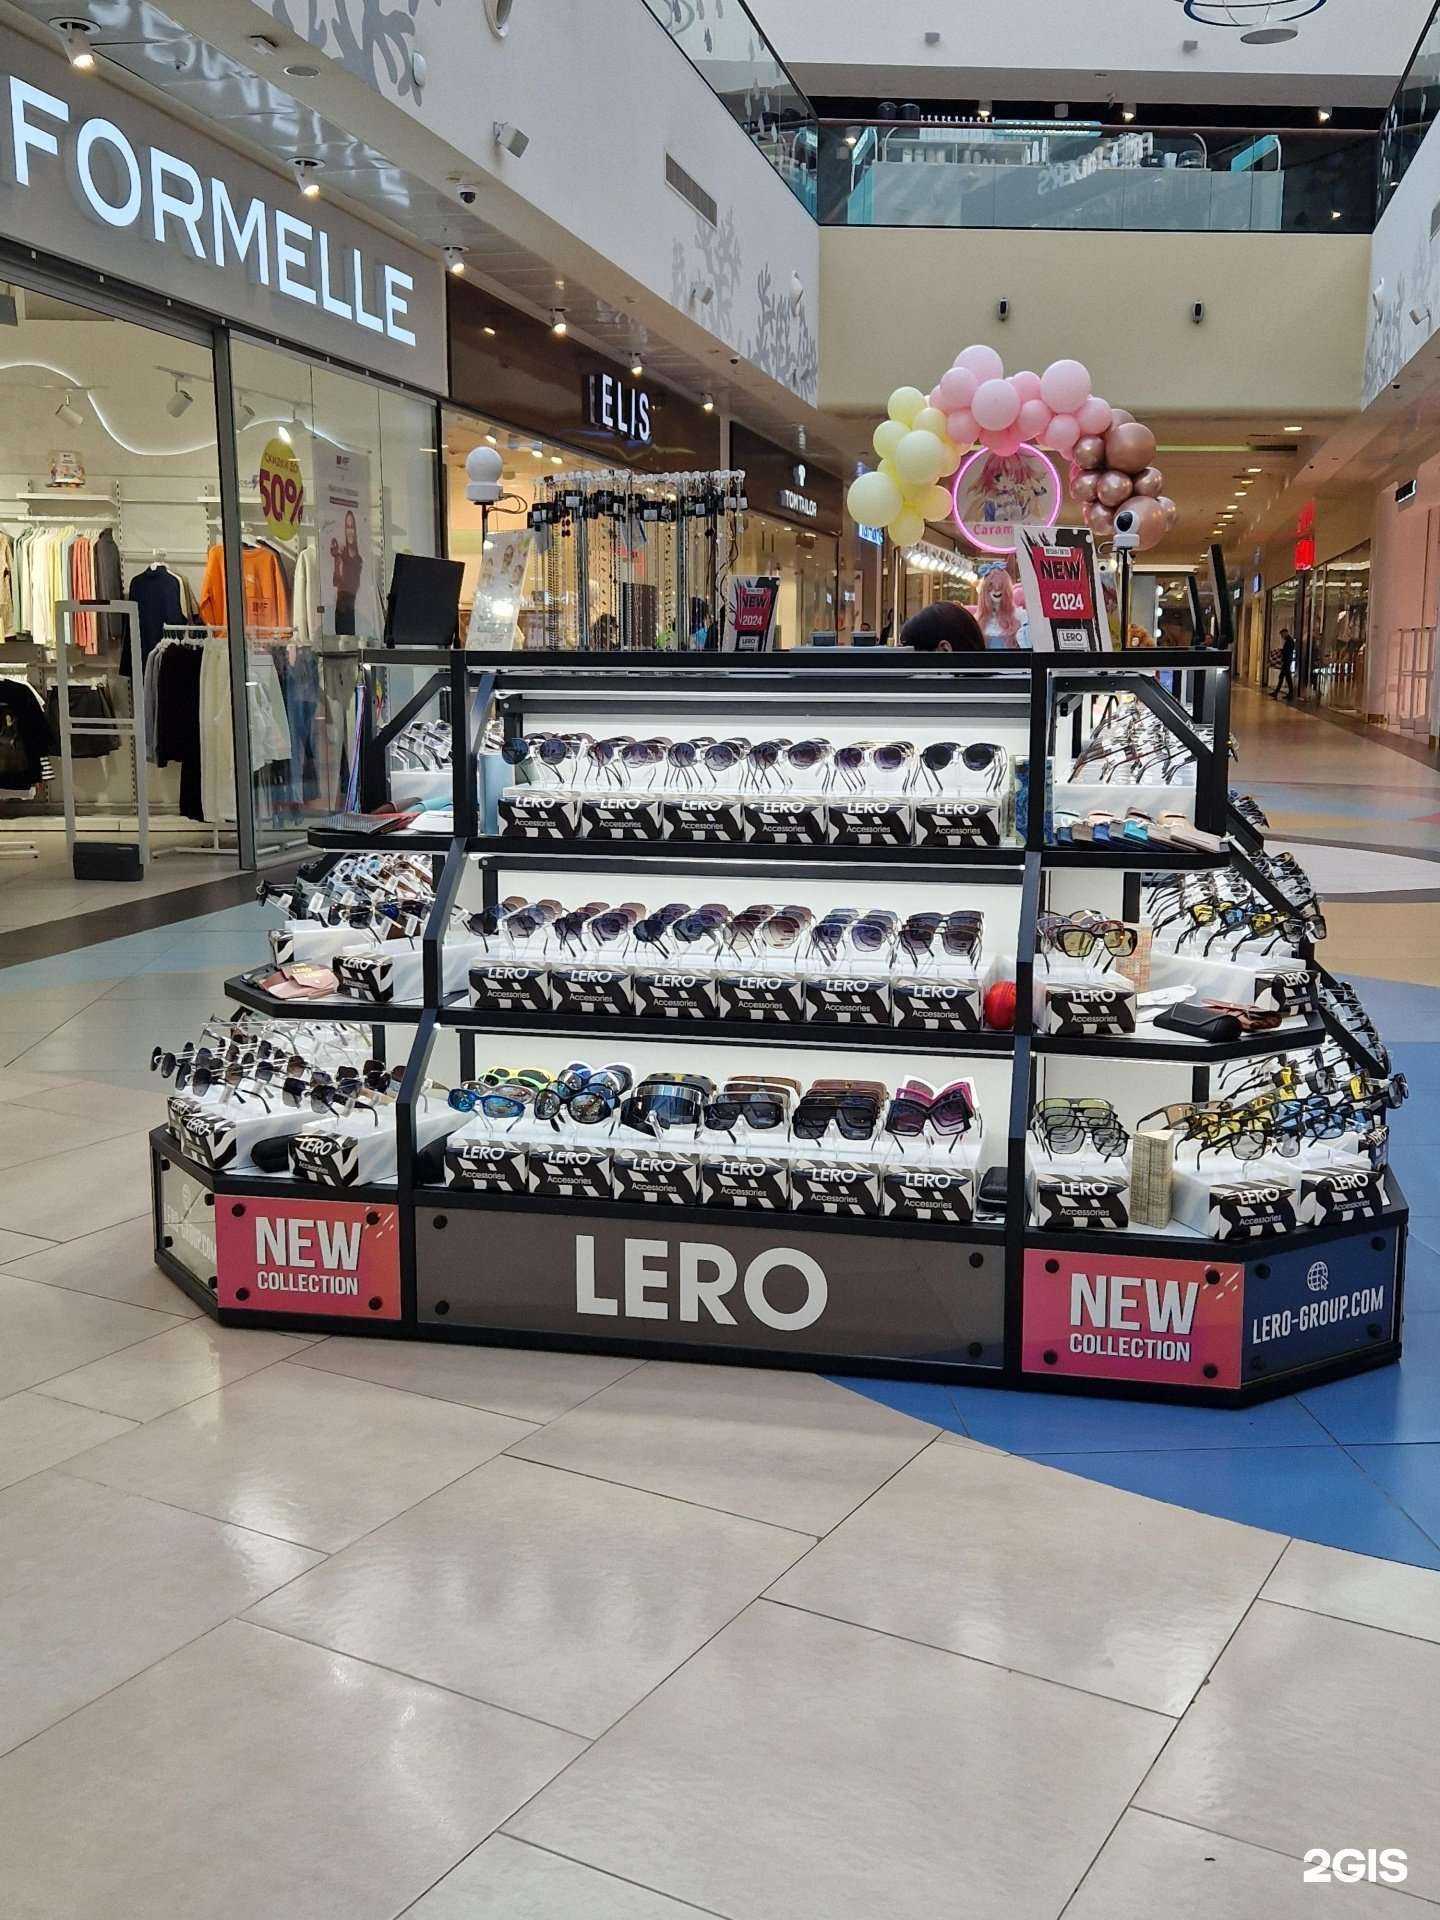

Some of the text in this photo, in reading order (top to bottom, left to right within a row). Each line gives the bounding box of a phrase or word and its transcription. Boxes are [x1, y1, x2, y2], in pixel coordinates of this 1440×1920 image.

[9, 75, 417, 347] FORMELLE
[259, 468, 304, 526] 50%
[785, 489, 818, 517] TOM TAILOR
[1040, 559, 1081, 581] NEW
[743, 595, 767, 608] NEW
[1051, 592, 1085, 611] 2024
[742, 615, 763, 626] 2024
[1062, 632, 1083, 642] LERO
[515, 797, 556, 809] LERO
[600, 798, 641, 810] LERO
[681, 799, 723, 811] LERO
[763, 802, 805, 814] LERO
[847, 802, 890, 814] LERO
[936, 803, 980, 816] LERO
[514, 819, 556, 828] Accessories
[599, 820, 642, 829] Accessories
[681, 821, 724, 831] Accessories
[762, 824, 806, 833] Accessories
[846, 825, 891, 834] Accessories
[935, 825, 981, 835] Accessories
[342, 956, 374, 971] LERO
[487, 967, 530, 980] LERO
[570, 970, 612, 983] LERO
[1283, 971, 1310, 987] LERO
[654, 975, 696, 988] LERO
[739, 977, 782, 991] LERO
[825, 980, 869, 993] LERO
[487, 989, 530, 999] Accessories
[569, 992, 613, 1003] Accessories
[913, 985, 958, 999] LERO
[1072, 989, 1117, 1003] LERO
[653, 998, 698, 1008] Accessories
[738, 1001, 783, 1010] Accessories
[824, 1002, 871, 1012] Accessories
[912, 1009, 960, 1019] Accessories
[1071, 1014, 1117, 1023] Accessories
[299, 1137, 332, 1156] LERO
[462, 1147, 505, 1161] LERO
[548, 1151, 591, 1165] LERO
[632, 1158, 676, 1173] LERO
[722, 1162, 766, 1176] LERO
[461, 1169, 506, 1181] Accessories
[547, 1175, 592, 1185] Accessories
[812, 1168, 857, 1183] LERO
[905, 1173, 951, 1189] LERO
[631, 1182, 677, 1193] Accessories
[1061, 1181, 1109, 1196] LERO
[1328, 1173, 1369, 1191] LERO
[720, 1186, 767, 1197] Accessories
[810, 1192, 858, 1204] Accessories
[1240, 1187, 1280, 1205] LERO
[903, 1198, 953, 1209] Accessories
[1060, 1207, 1110, 1217] Accessories
[1239, 1214, 1282, 1226] Accessories
[255, 1216, 362, 1271] NEW
[256, 1270, 359, 1296] COLLECTION
[575, 1234, 829, 1331] LERO
[1070, 1273, 1199, 1335] NEW
[1252, 1285, 1385, 1346] LERO-GROUP.COM
[1069, 1332, 1191, 1363] COLLECTION
